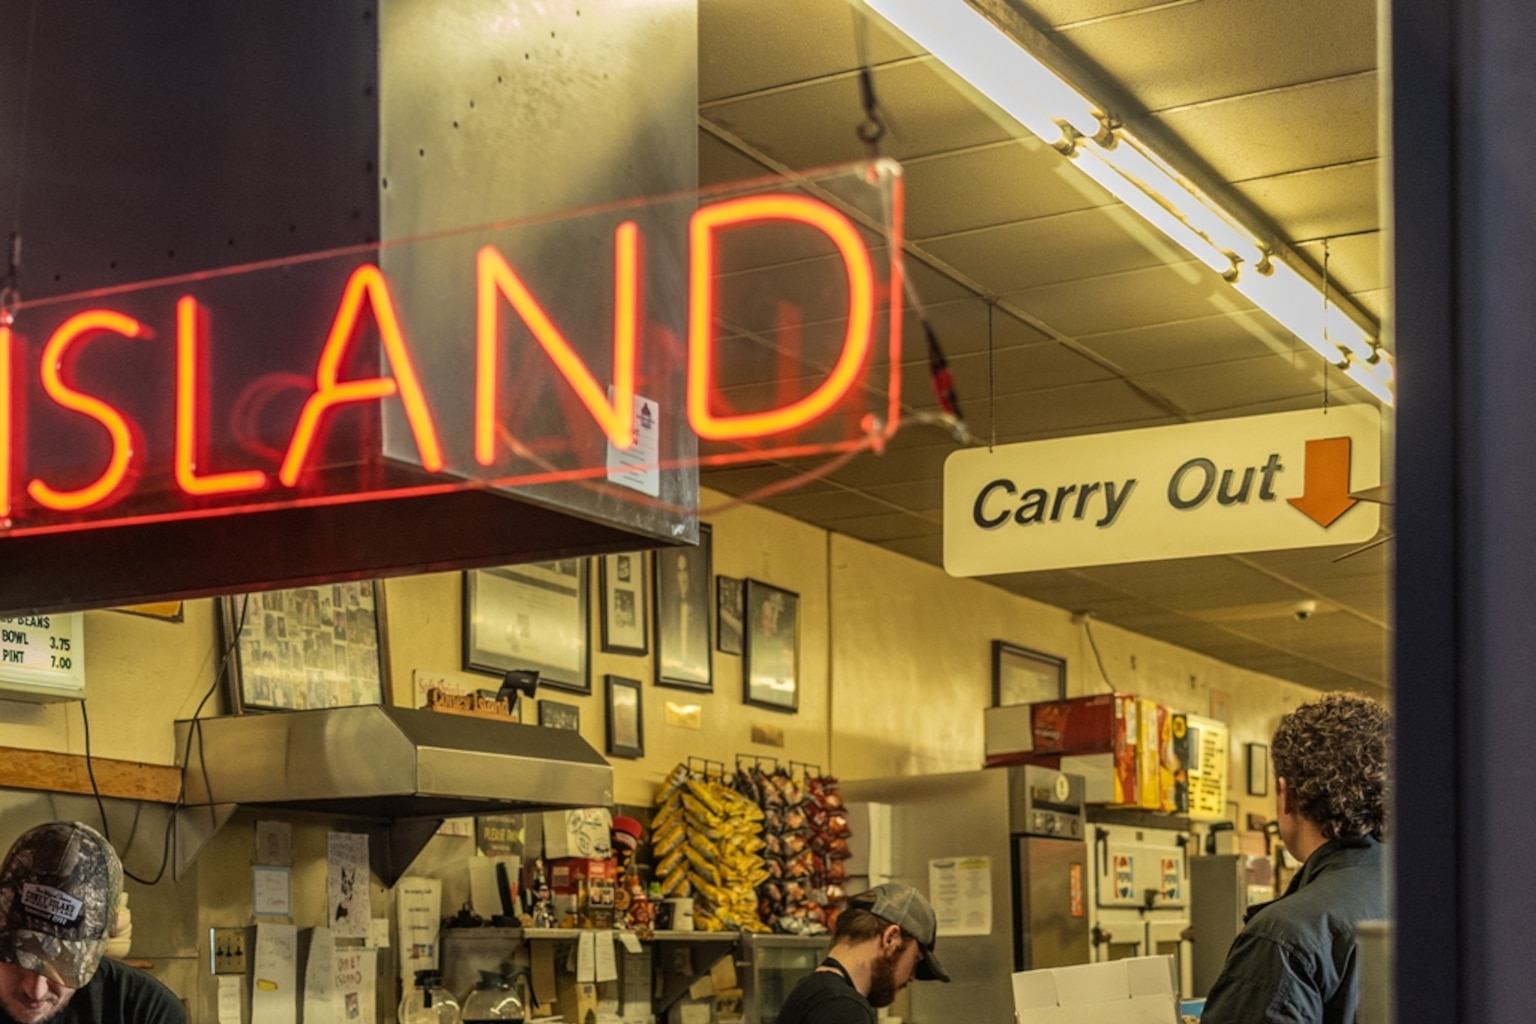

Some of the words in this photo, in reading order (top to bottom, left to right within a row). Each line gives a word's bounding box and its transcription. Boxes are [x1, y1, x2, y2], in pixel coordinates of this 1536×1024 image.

[972, 476, 1136, 529] Carry
[1167, 452, 1283, 510] Out
[17, 615, 50, 629] BEANS
[1, 629, 29, 645] BOWL
[49, 636, 71, 651] 3.75
[2, 648, 25, 663] PINT
[50, 655, 72, 670] 7.00
